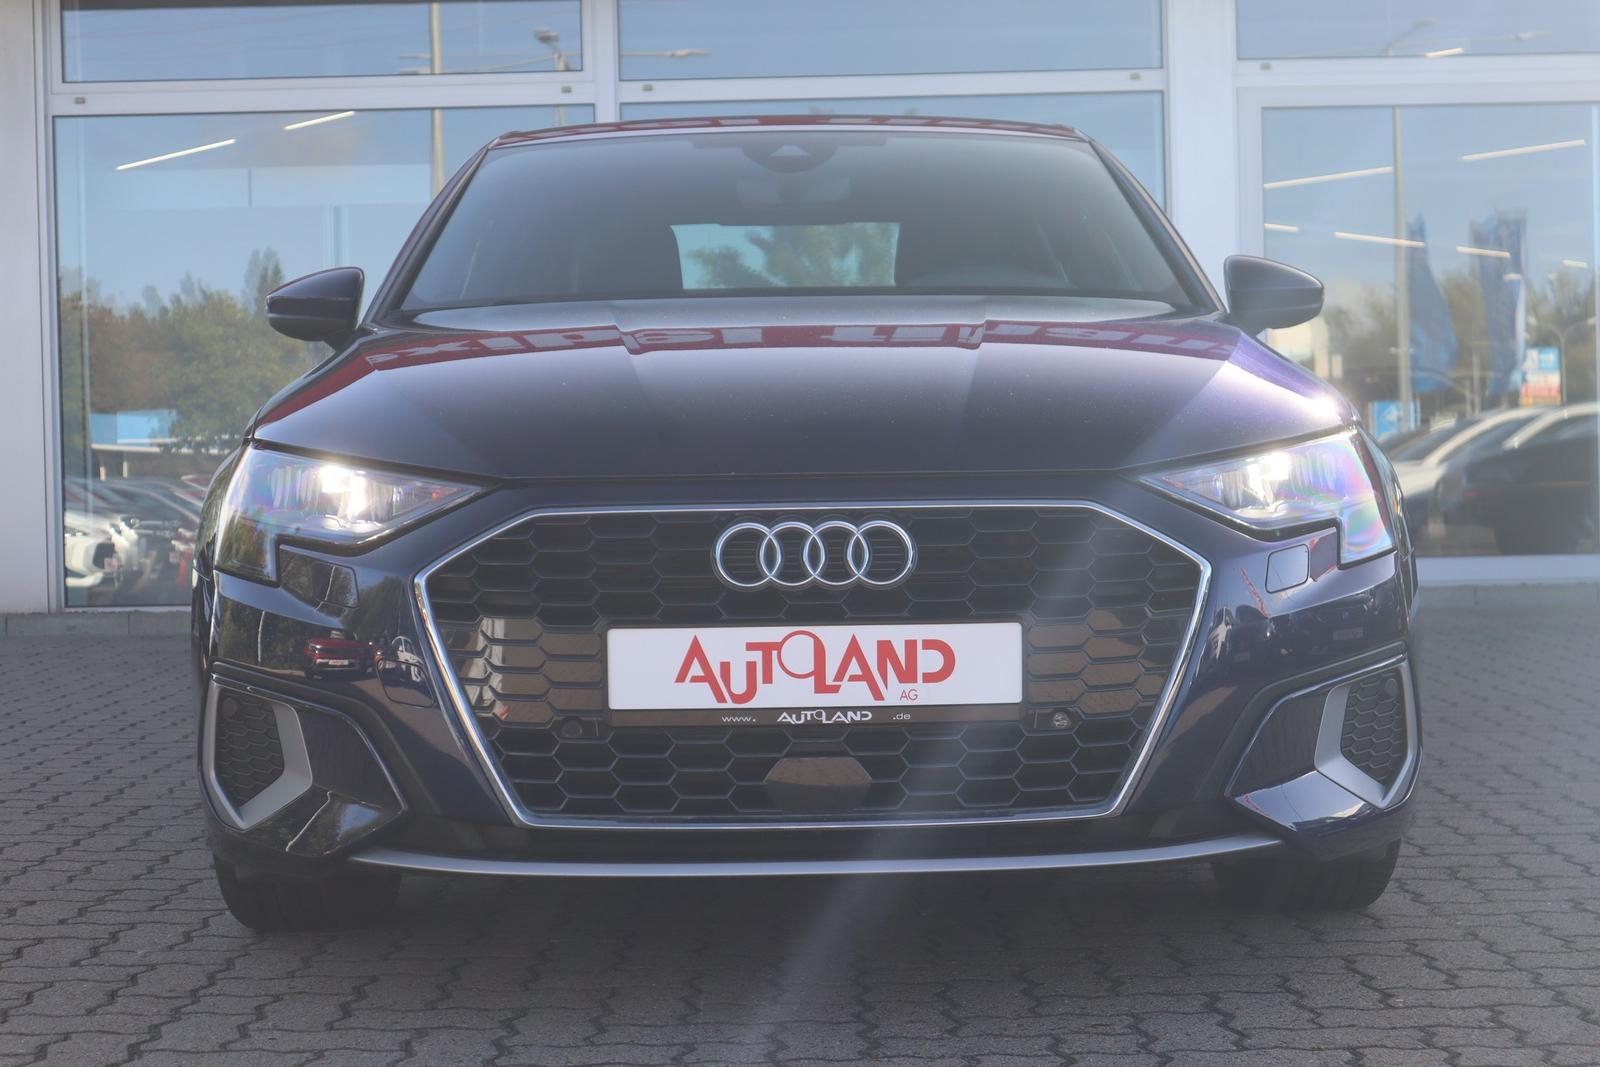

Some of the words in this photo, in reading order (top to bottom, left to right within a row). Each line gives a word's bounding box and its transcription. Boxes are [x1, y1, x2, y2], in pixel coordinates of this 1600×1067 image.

[900, 688, 918, 701] AG
[721, 715, 756, 723] www.
[776, 709, 872, 725] AUTOLAND
[892, 712, 911, 720] .de
